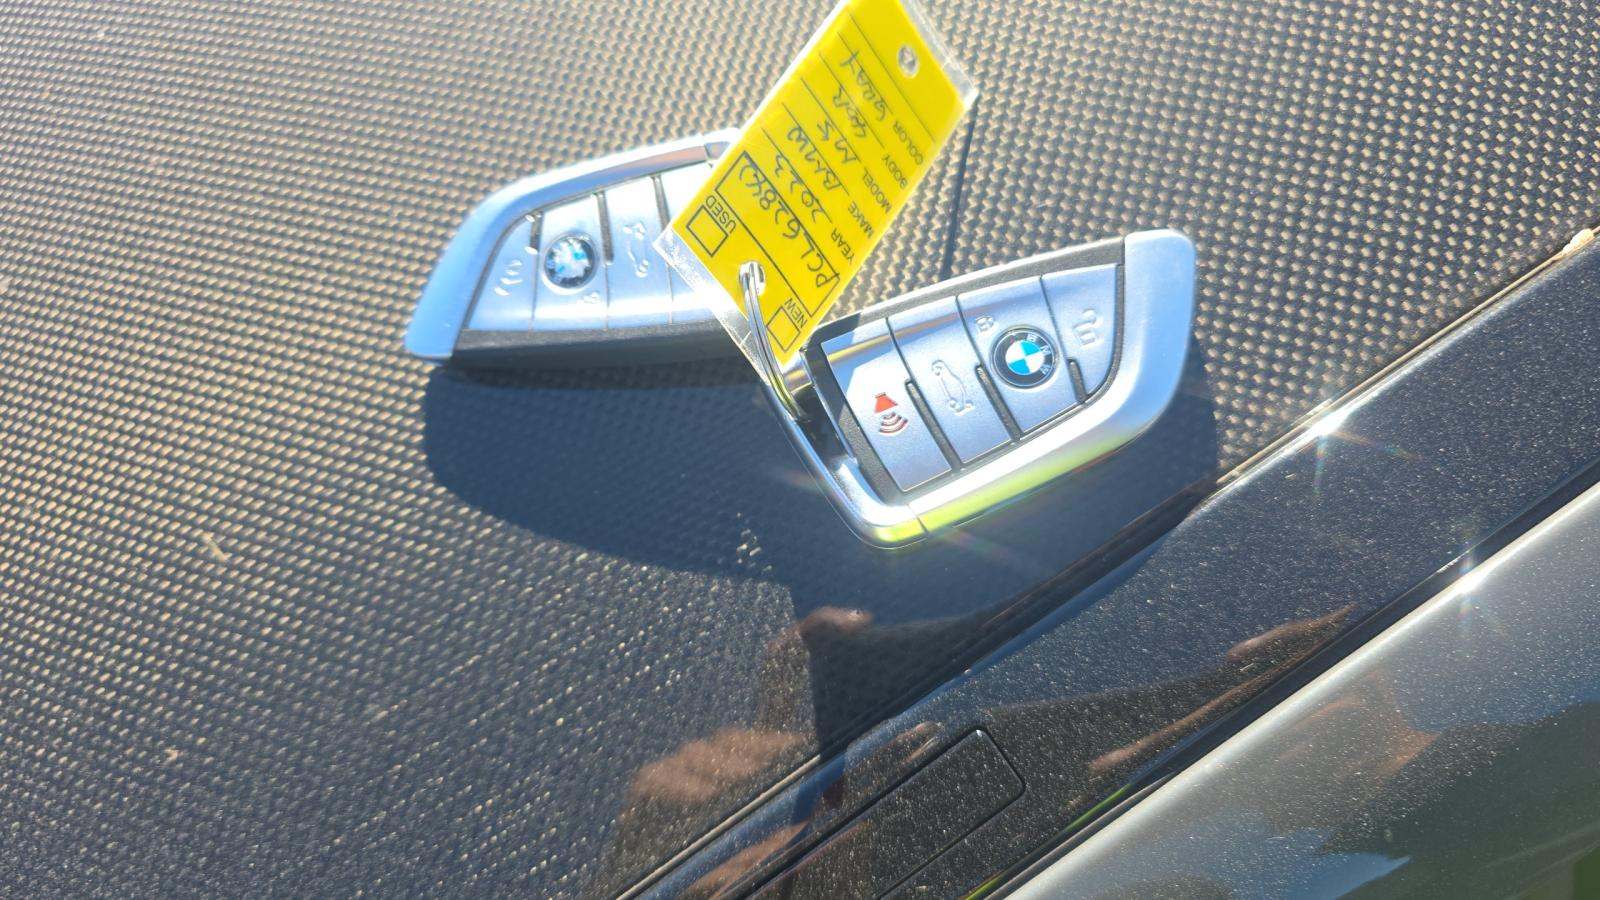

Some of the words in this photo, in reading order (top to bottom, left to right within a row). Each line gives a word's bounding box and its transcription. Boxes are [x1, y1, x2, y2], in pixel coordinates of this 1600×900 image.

[787, 126, 841, 190] BMW
[893, 121, 924, 166] COLOR
[775, 154, 824, 224] 2023
[862, 167, 892, 213] MODEL
[882, 154, 908, 189] BODY
[705, 195, 737, 233] USED
[848, 202, 875, 239] MAKE
[831, 228, 855, 264] YEAR
[784, 297, 807, 328] NEW
